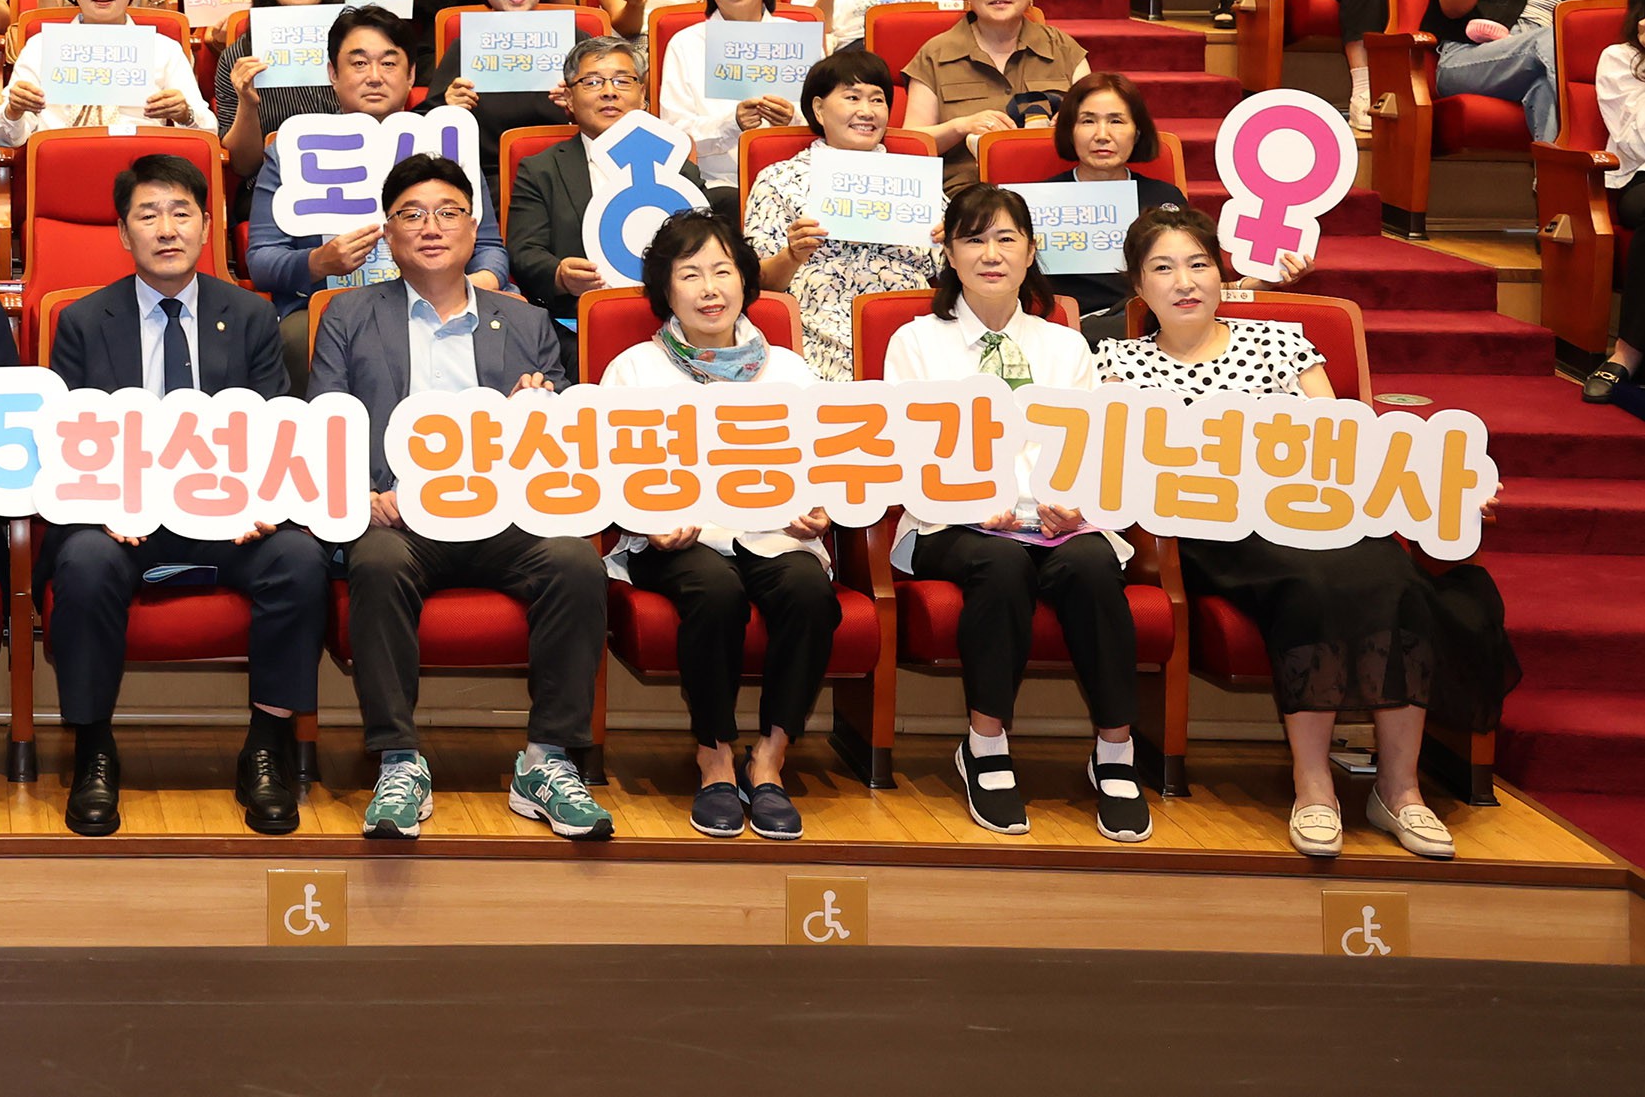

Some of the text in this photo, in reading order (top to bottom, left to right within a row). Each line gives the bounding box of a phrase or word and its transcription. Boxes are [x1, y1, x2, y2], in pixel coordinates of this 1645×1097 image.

[480, 31, 558, 50] 화성특례시
[723, 41, 803, 60] 화성특례시
[60, 44, 138, 63] 화성특례시
[471, 53, 566, 72] 4개 구청 승인
[51, 66, 146, 86] 4개 구청 승인
[714, 62, 810, 83] 4개 구청 승인
[832, 171, 921, 198] 화성특례시
[821, 198, 932, 224] 4개 구청 승인
[1029, 205, 1117, 226] 화성특례시
[1051, 230, 1087, 251] 구청
[55, 409, 348, 520] 화성시
[408, 395, 1005, 520] 양성평등주간
[1026, 402, 1478, 542] 기념행사
